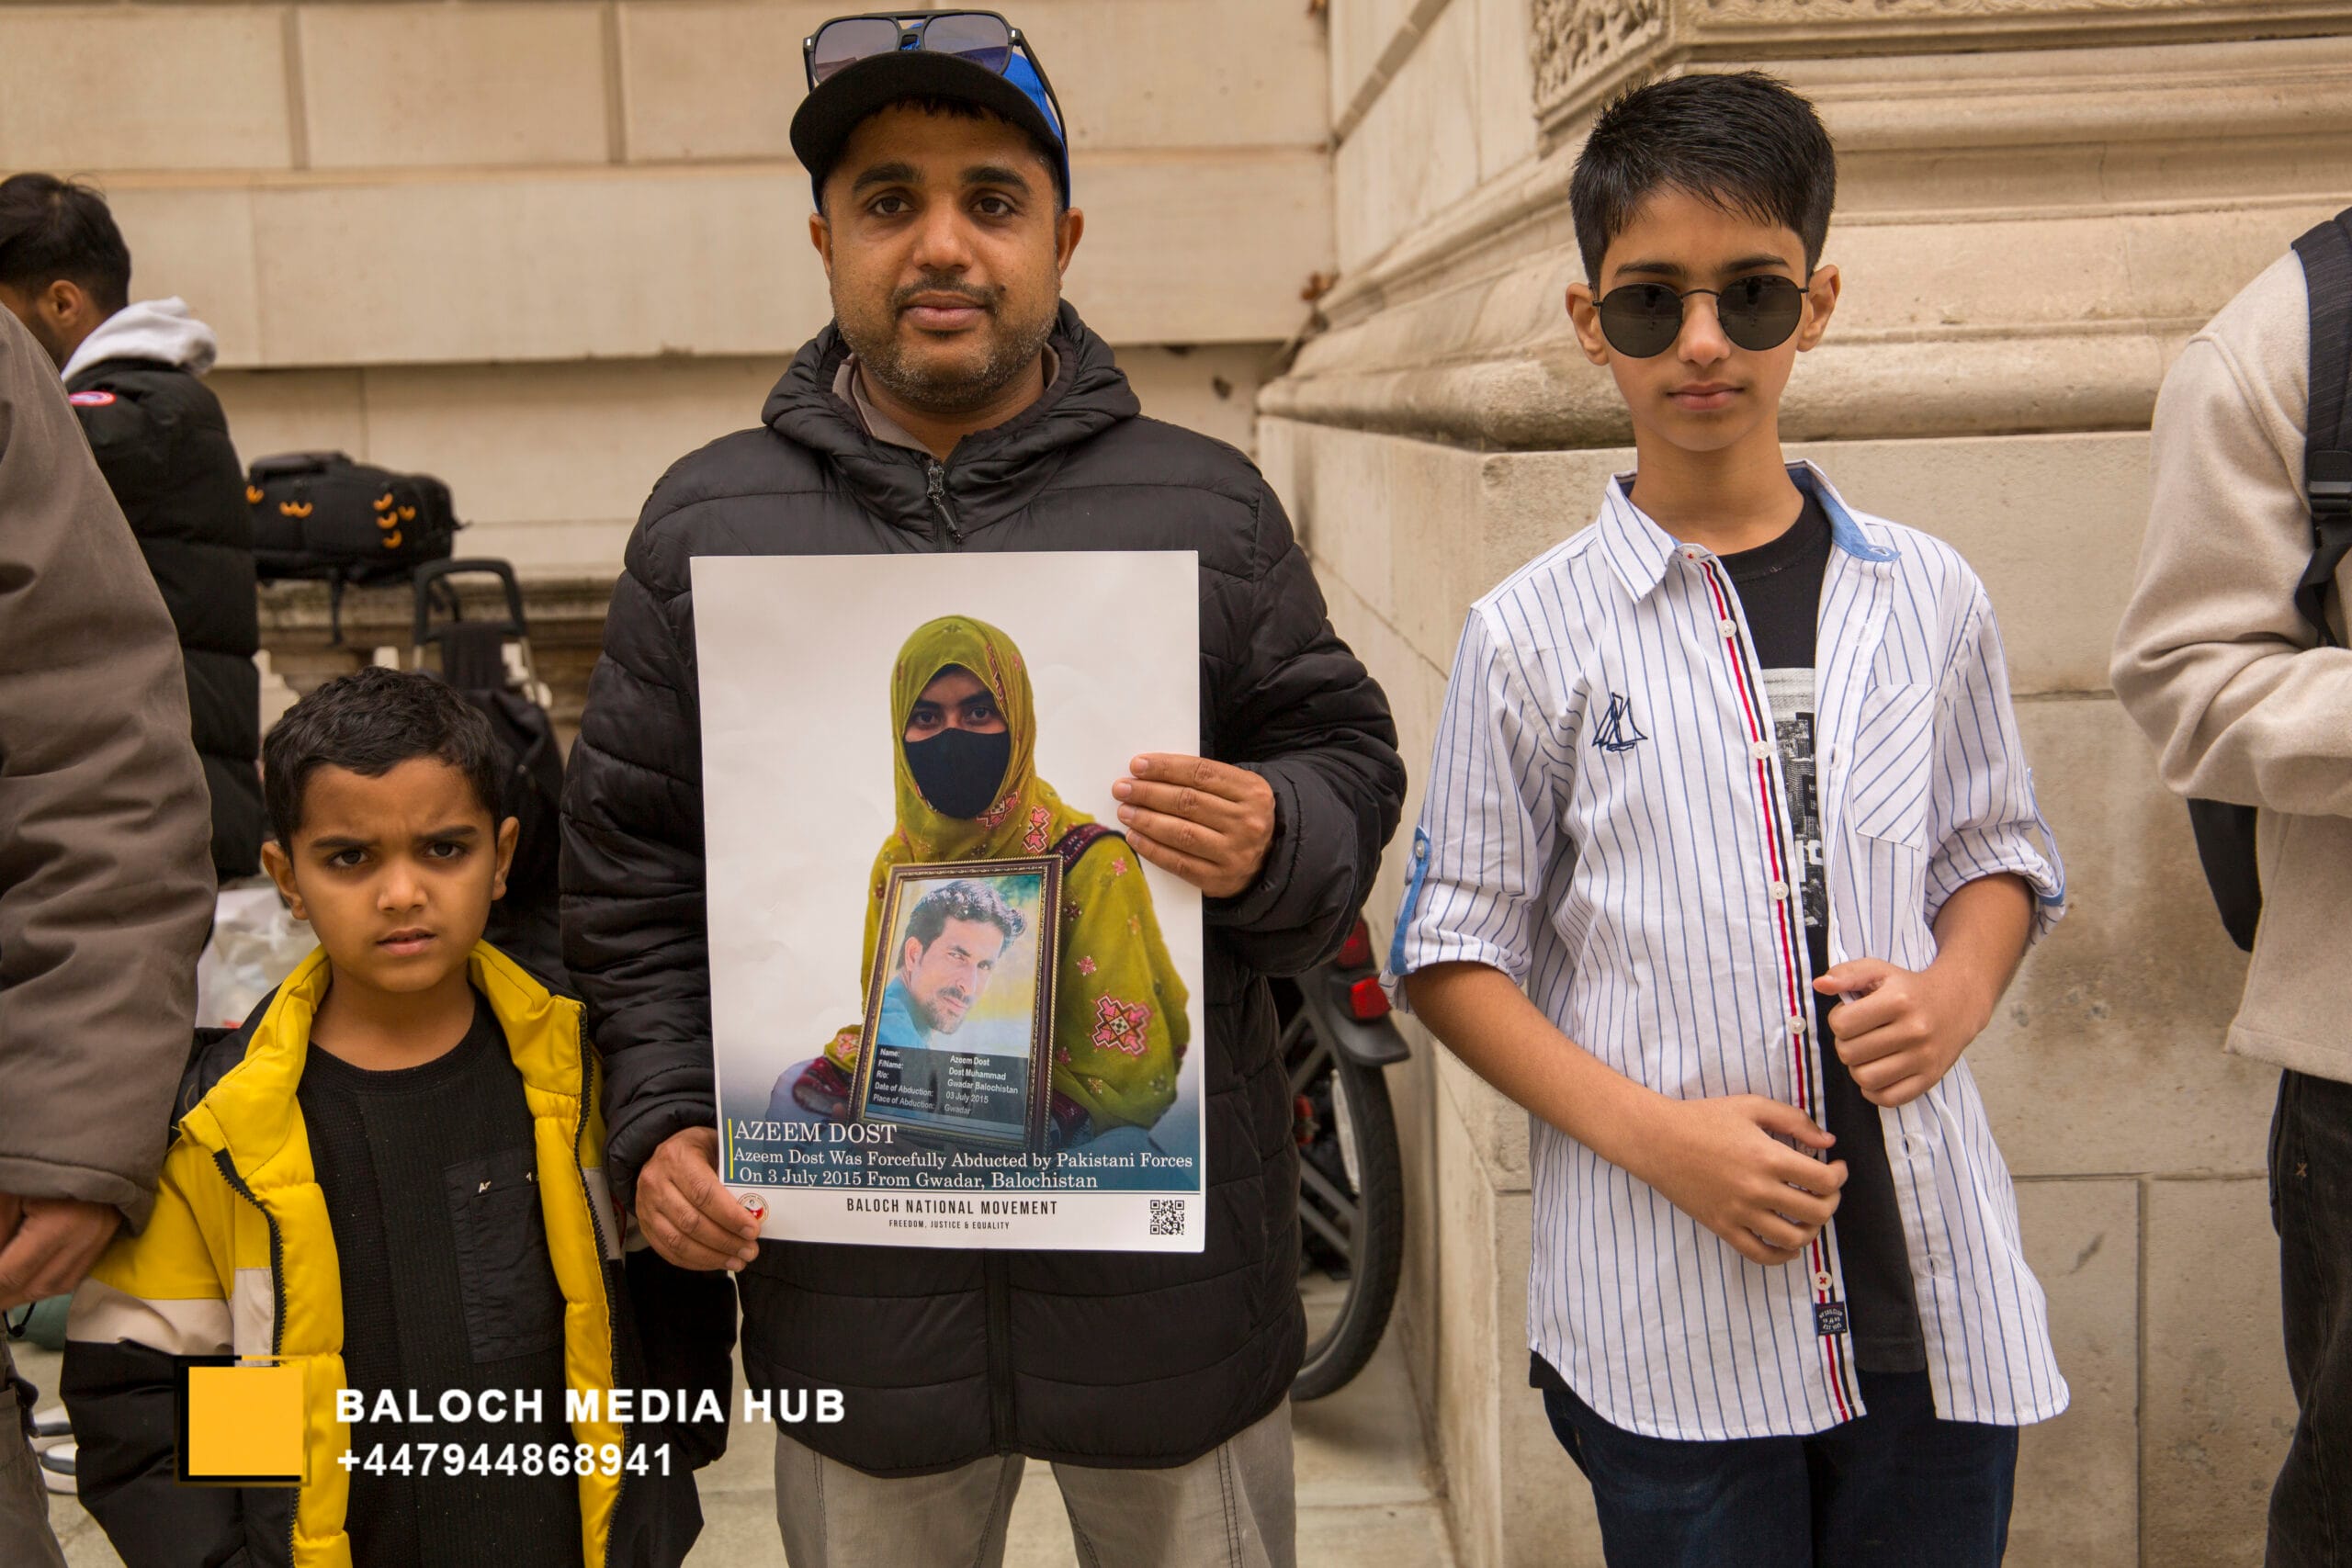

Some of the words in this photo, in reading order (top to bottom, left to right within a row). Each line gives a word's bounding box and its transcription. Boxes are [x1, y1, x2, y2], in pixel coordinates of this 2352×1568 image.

[950, 1055, 973, 1065] Azeem
[974, 1057, 990, 1066] Dost
[949, 1067, 964, 1076] Dost
[965, 1068, 1007, 1080] Muhammad
[875, 1082, 889, 1090] Date
[945, 1091, 954, 1100] 03
[956, 1092, 969, 1103] July
[970, 1095, 989, 1103] 2015
[947, 1078, 974, 1089] Gwadar
[975, 1081, 1019, 1094] Balochistan
[873, 1094, 890, 1102] Place
[944, 1104, 971, 1114] Gwadar
[734, 1121, 821, 1142] AZEEM
[829, 1122, 898, 1144] DOST
[733, 1146, 784, 1163] Azeem
[788, 1149, 825, 1164] Dost
[829, 1150, 863, 1166] Was
[866, 1151, 947, 1169] Forcefully
[951, 1152, 1027, 1168] Abducted
[1033, 1154, 1052, 1170] by
[1057, 1152, 1135, 1168] Pakistani
[1139, 1152, 1193, 1168] Forces
[740, 1167, 763, 1183] On
[768, 1168, 777, 1183] 3
[782, 1168, 818, 1187] July
[822, 1170, 862, 1186] 2015
[866, 1171, 910, 1187] From
[916, 1171, 986, 1190] Gwadar,
[991, 1171, 1099, 1189] Balochistan
[847, 1198, 899, 1213] BALOCH
[906, 1200, 974, 1214] NATIONAL
[981, 1201, 1057, 1215] MOVEMENT
[931, 1220, 961, 1229] JUSTICE
[965, 1221, 969, 1229] &
[972, 1221, 1010, 1229] EQUALITY
